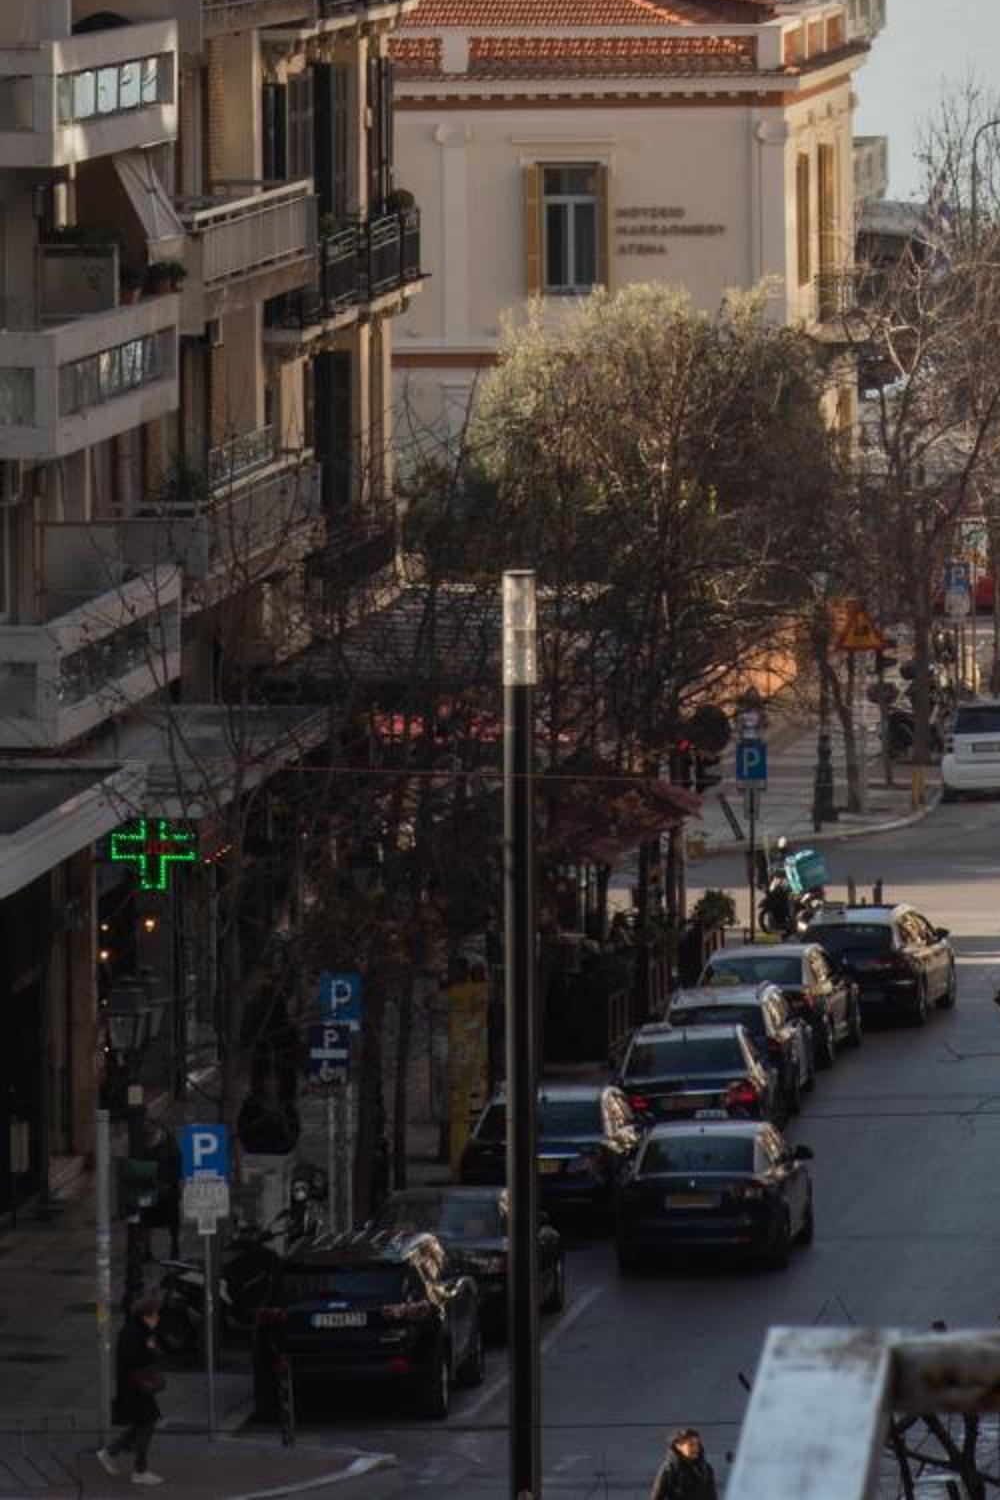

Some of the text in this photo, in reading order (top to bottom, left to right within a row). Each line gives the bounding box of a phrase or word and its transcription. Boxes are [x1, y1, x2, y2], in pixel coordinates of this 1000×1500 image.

[742, 746, 760, 777] P
[332, 979, 352, 1010] P
[323, 1029, 338, 1048] P
[192, 1132, 219, 1166] P
